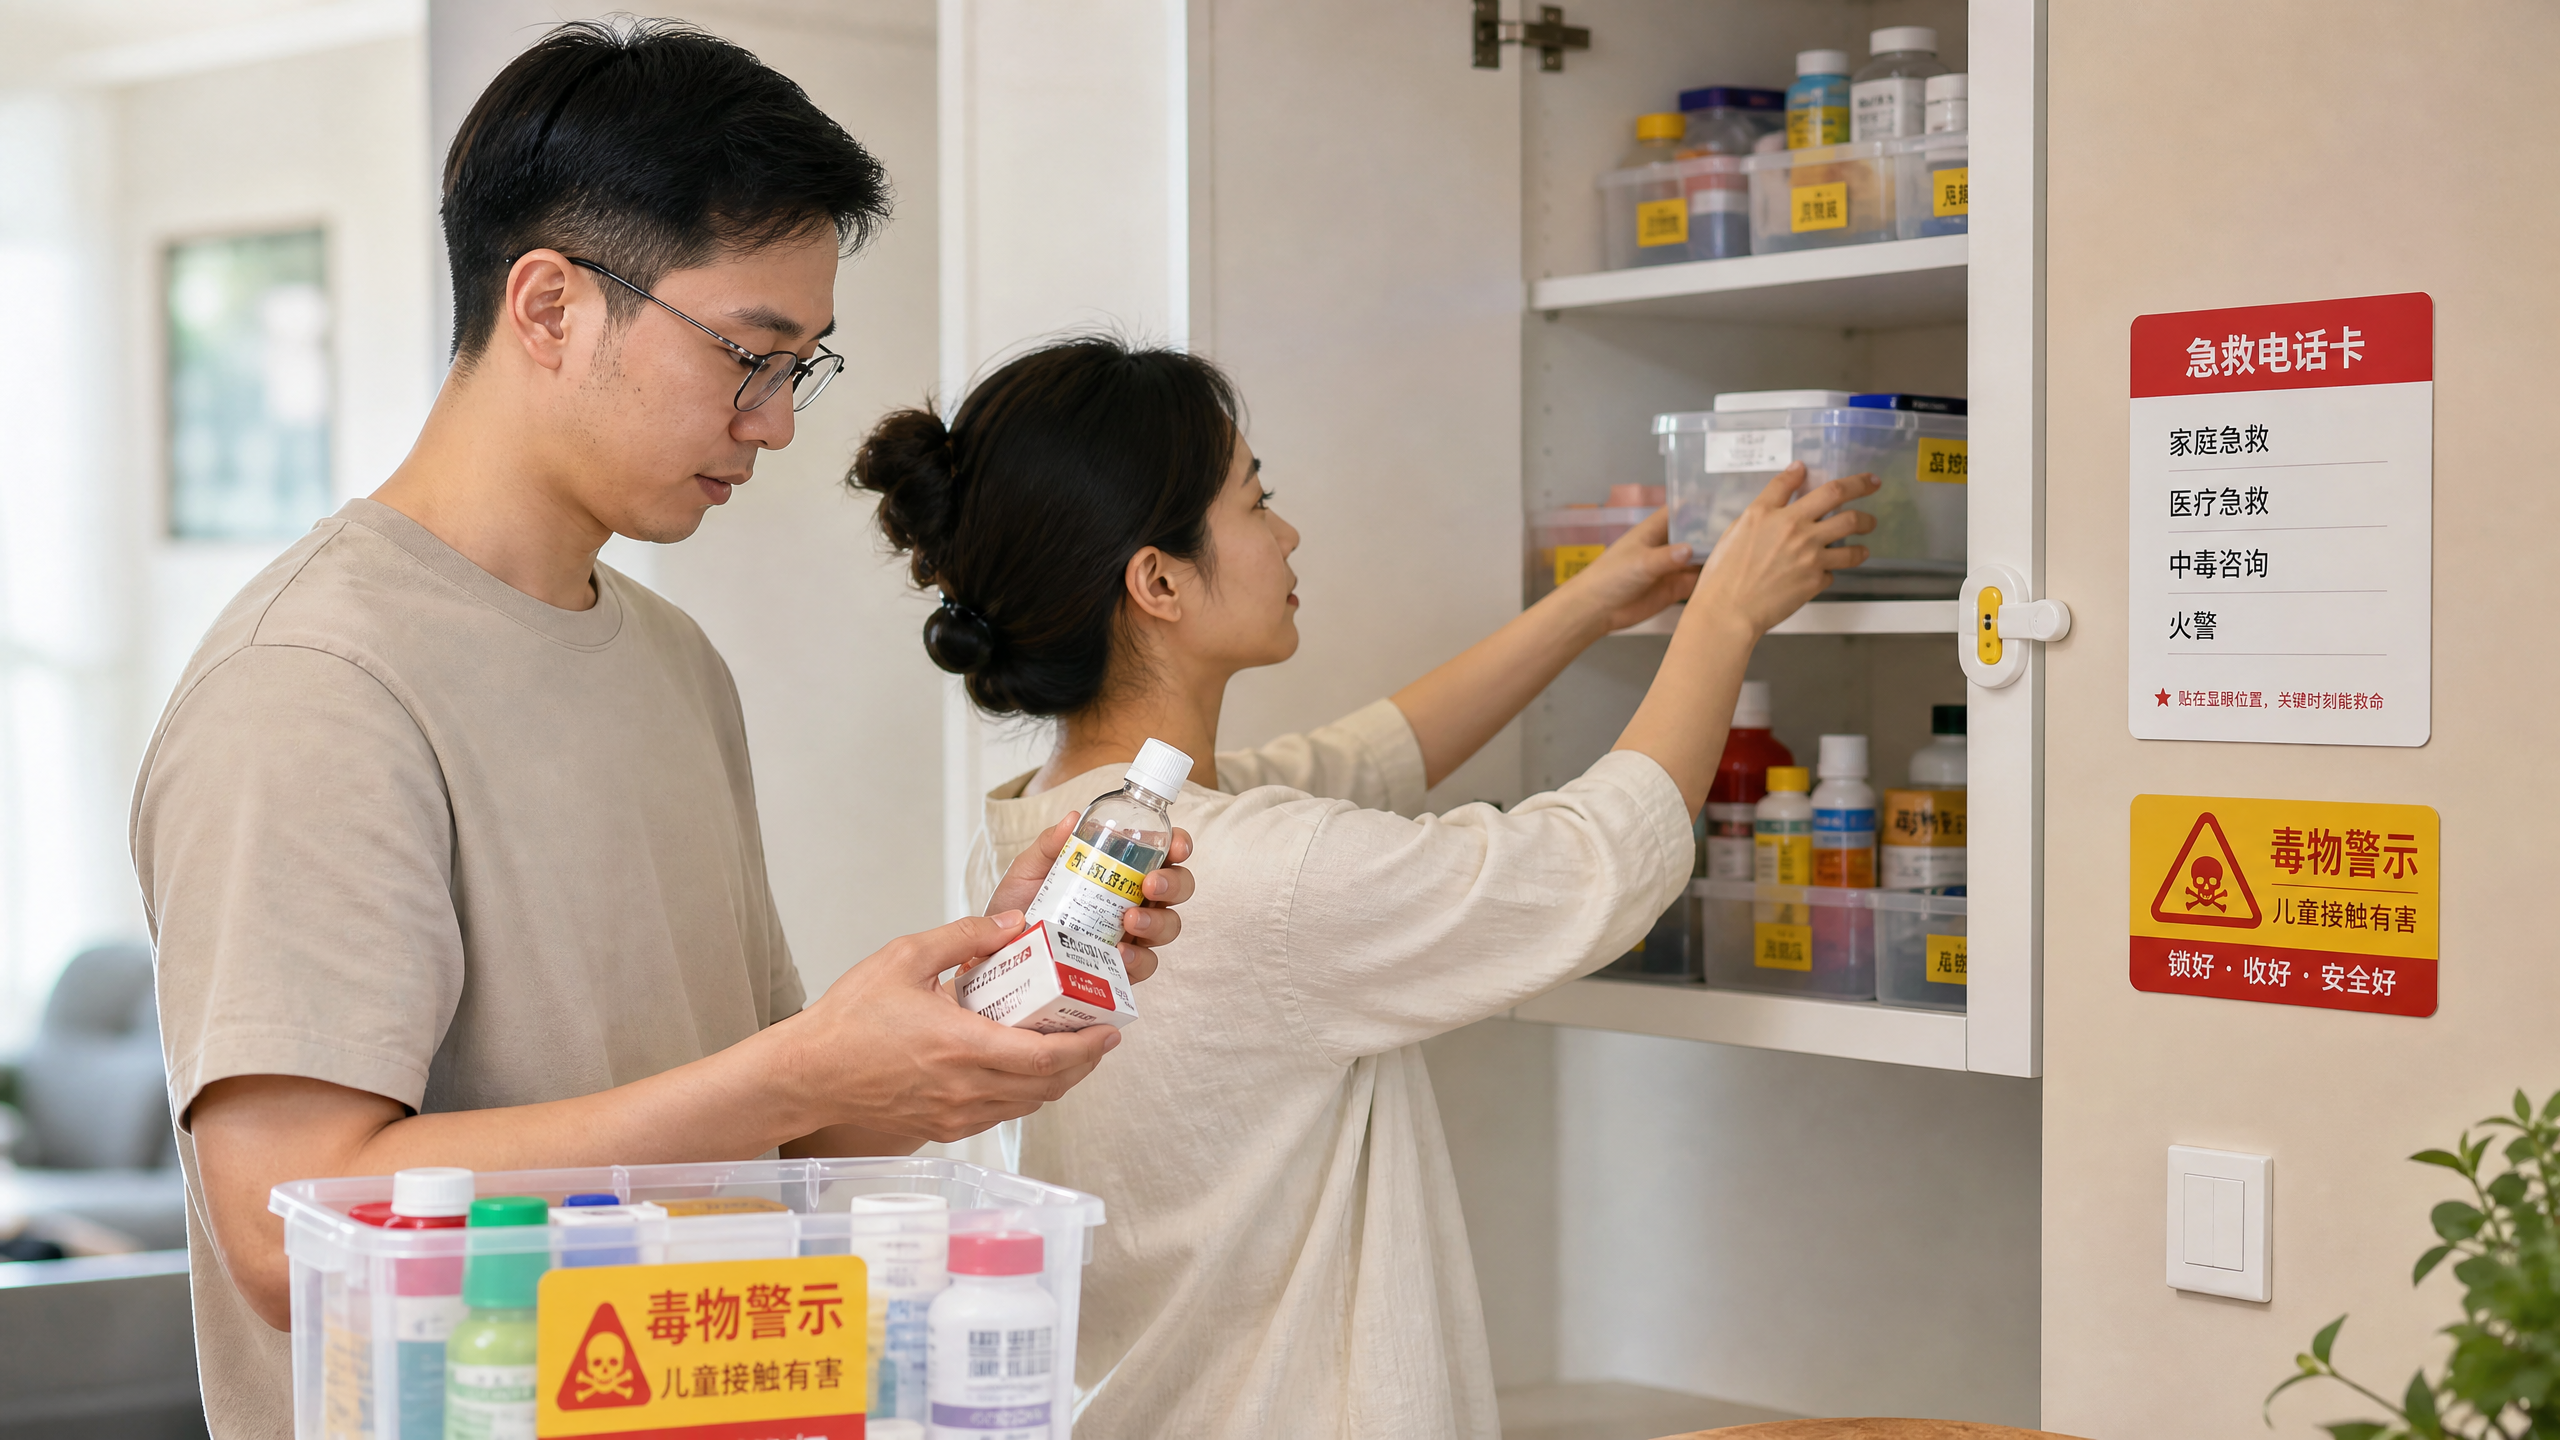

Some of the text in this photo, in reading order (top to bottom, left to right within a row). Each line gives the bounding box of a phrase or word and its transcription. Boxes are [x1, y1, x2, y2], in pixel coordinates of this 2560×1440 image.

[2185, 325, 2366, 379] 急救电话卡
[2168, 423, 2270, 457] 家庭急救
[2169, 485, 2270, 518] 医疗急救
[2168, 548, 2269, 580] 中毒咨询
[2168, 610, 2218, 641] 火警
[2270, 826, 2419, 880] 毒物警示
[2272, 897, 2417, 934] 儿童接触有害
[646, 1282, 844, 1346] 毒物警示
[660, 1356, 844, 1400] 儿童接触有害
